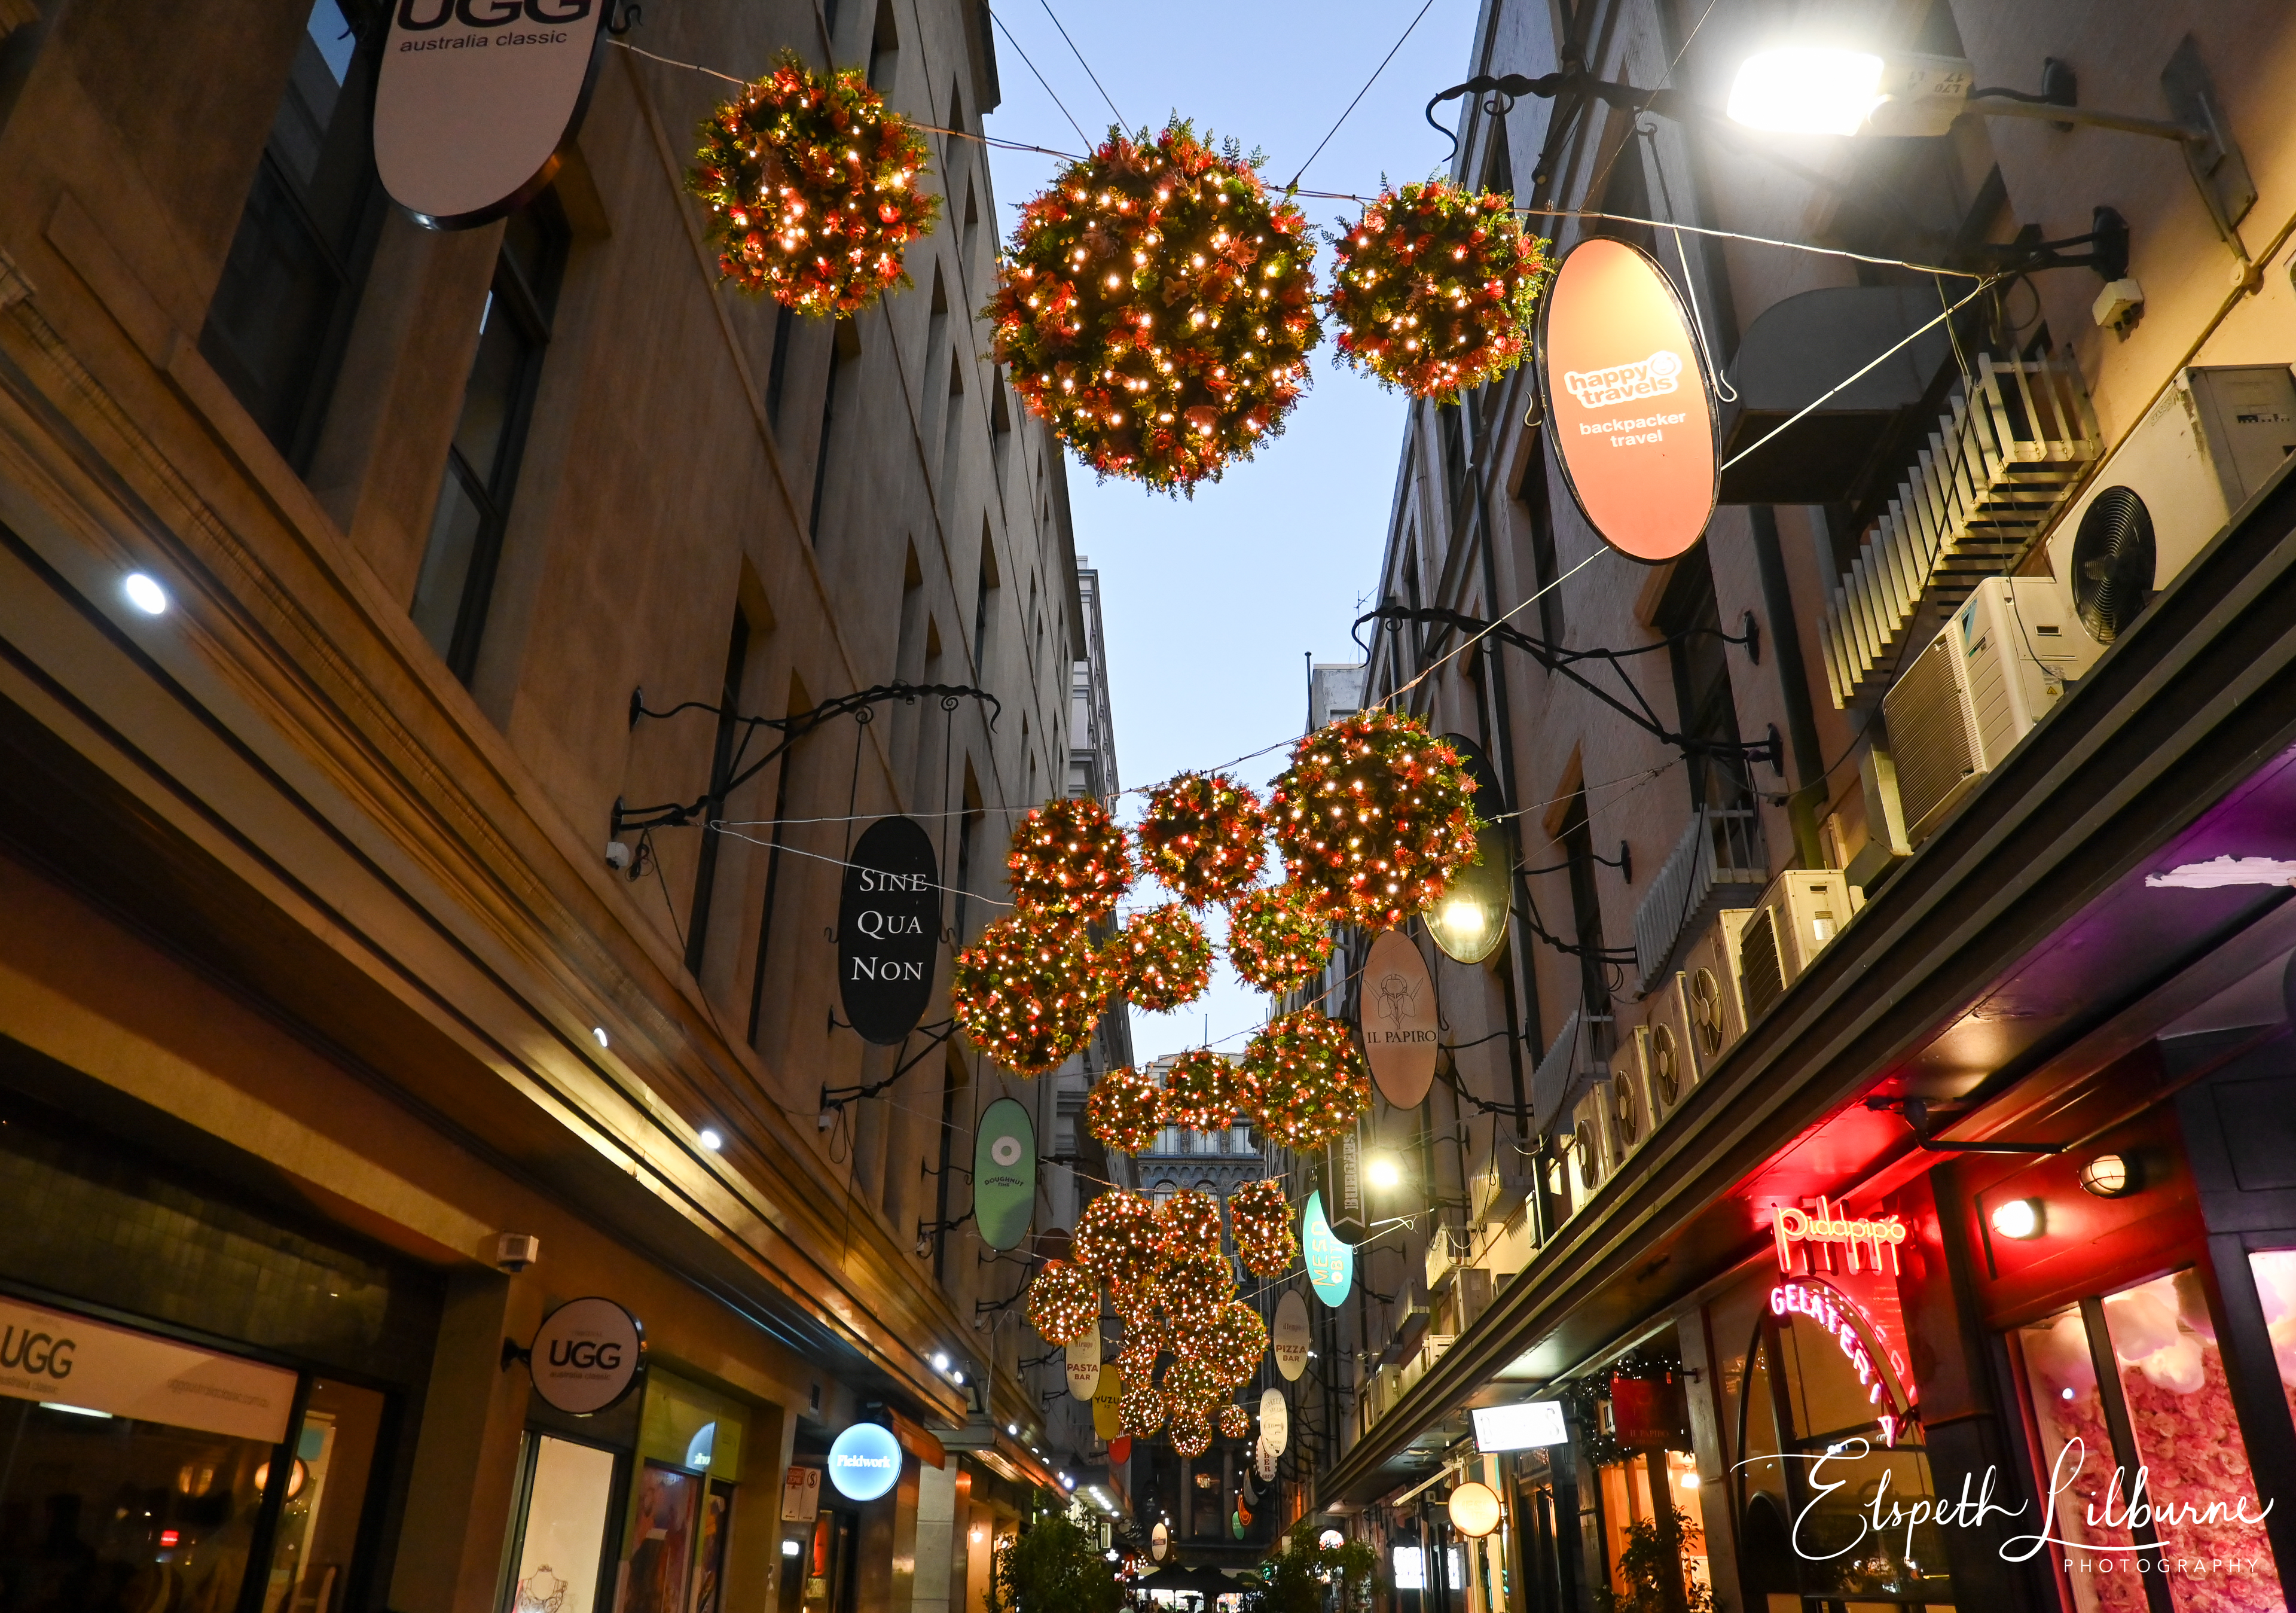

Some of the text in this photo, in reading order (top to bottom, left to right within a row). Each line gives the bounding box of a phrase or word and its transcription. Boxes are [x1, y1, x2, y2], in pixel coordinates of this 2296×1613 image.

[399, 31, 567, 52] australia classic
[1569, 365, 1647, 391] happy
[1581, 376, 1673, 404] travels
[1579, 413, 1686, 435] backpacker
[1610, 429, 1663, 447] travel
[859, 868, 927, 892] SINE
[857, 910, 923, 940] QUA
[851, 957, 924, 980] NON
[1367, 1030, 1437, 1043] IL PAPIRO
[984, 1176, 1024, 1188] DOUGHNUT
[1344, 1133, 1358, 1209] BURGERS
[1312, 1221, 1336, 1286] MESO
[1, 1325, 76, 1380] UGG
[549, 1340, 622, 1370] UGG
[1276, 1345, 1306, 1353] PIZZA
[1067, 1364, 1099, 1372] PASTA
[1770, 1284, 1897, 1448] GELATERIA
[1095, 1395, 1119, 1404] YUZU
[837, 1455, 891, 1468] Fieldwork
